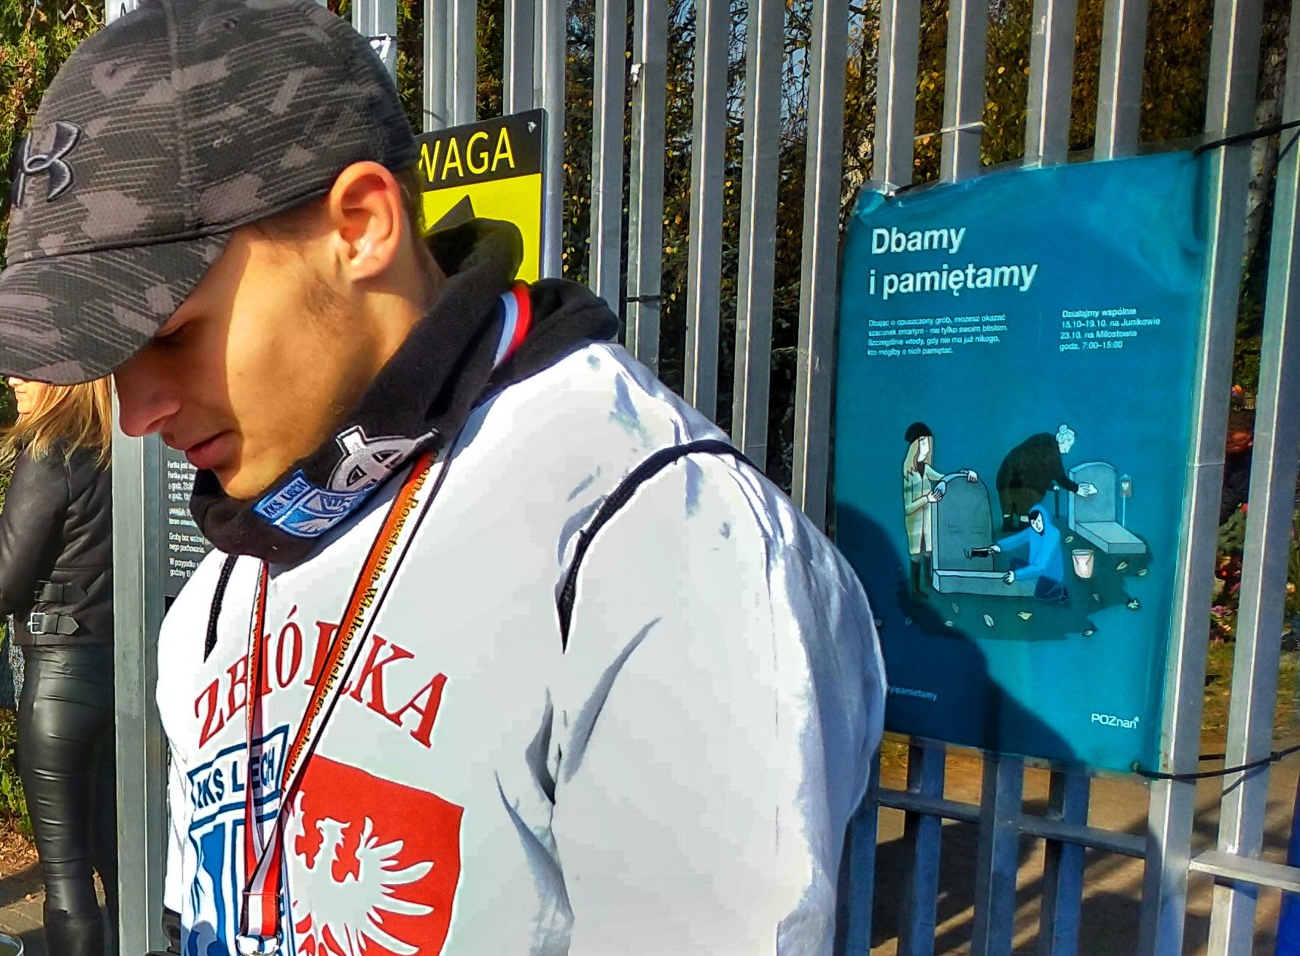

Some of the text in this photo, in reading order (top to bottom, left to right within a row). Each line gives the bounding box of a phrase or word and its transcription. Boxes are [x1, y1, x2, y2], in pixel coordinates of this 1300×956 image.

[418, 126, 515, 182] WAGA
[871, 226, 967, 255] Dbamy
[869, 263, 1039, 300] i pamiętamy
[1061, 307, 1137, 318] Działajmy wspólnie
[1120, 317, 1161, 327] Junikowie
[1059, 342, 1080, 352] godz.
[262, 499, 283, 518] KKS
